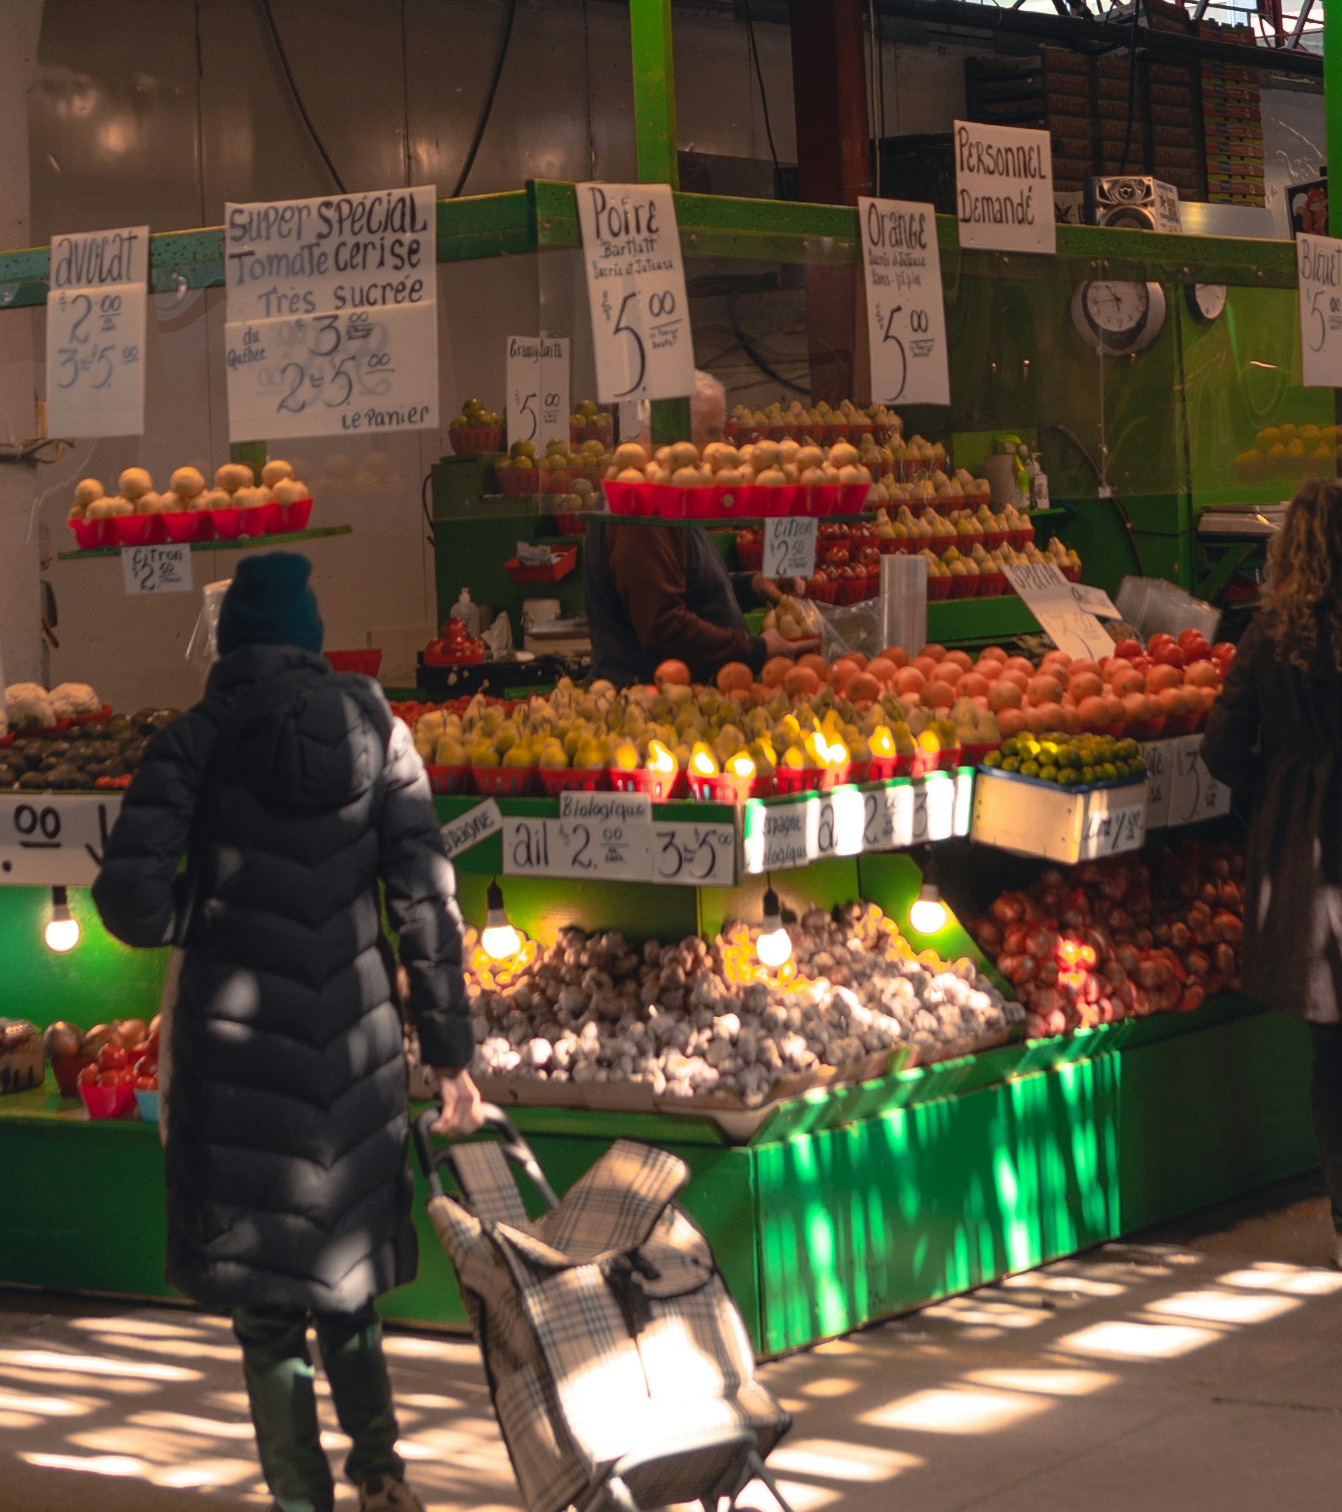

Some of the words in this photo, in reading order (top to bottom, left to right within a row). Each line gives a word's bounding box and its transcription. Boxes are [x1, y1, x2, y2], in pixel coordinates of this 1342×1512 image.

[229, 240, 328, 285] Tomate
[258, 284, 317, 316] Très
[333, 275, 424, 310] sucrée
[367, 404, 429, 427] Panier
[513, 819, 551, 868] ail
